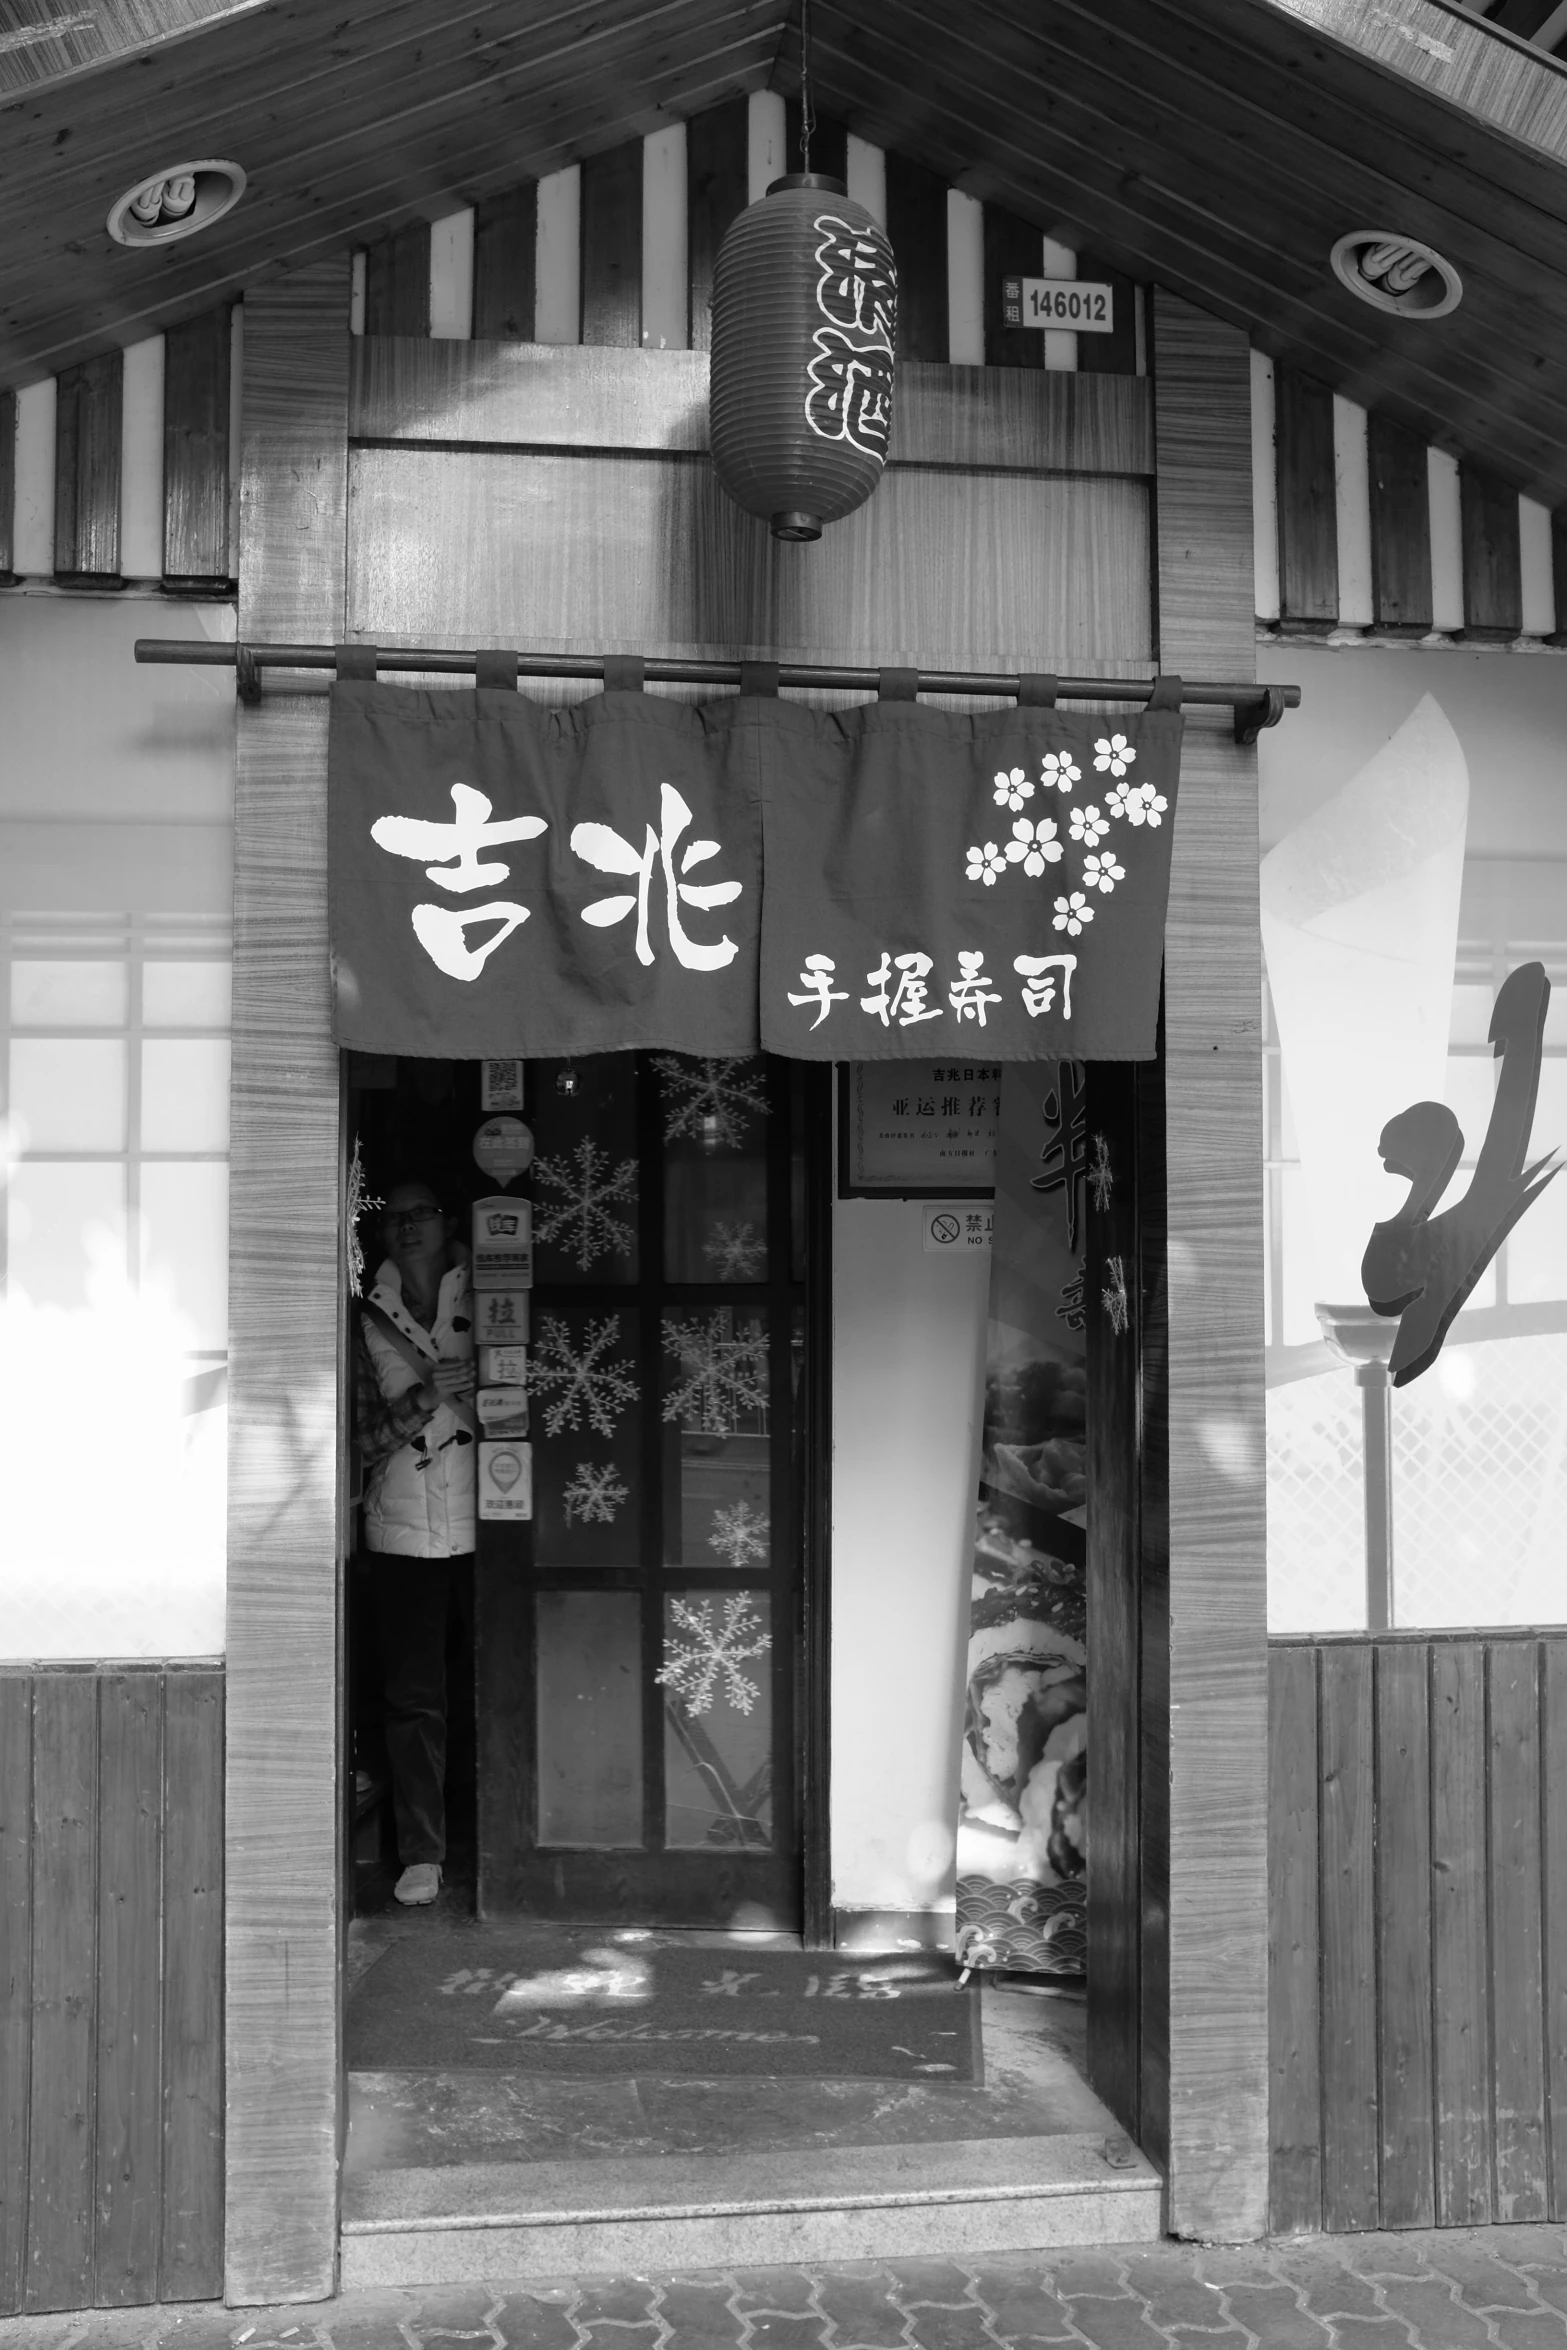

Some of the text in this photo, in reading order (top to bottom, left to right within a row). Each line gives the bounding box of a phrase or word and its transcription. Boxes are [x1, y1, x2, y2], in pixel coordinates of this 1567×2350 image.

[1005, 282, 1020, 322] 番租
[1030, 289, 1106, 322] 146012
[370, 782, 743, 982] 吉兆
[787, 950, 1078, 1031] 手握寿司
[967, 1236, 983, 1245] NO
[488, 1297, 516, 1324] 拉
[486, 1328, 516, 1339] PULL
[490, 2013, 820, 2045] Welcome
